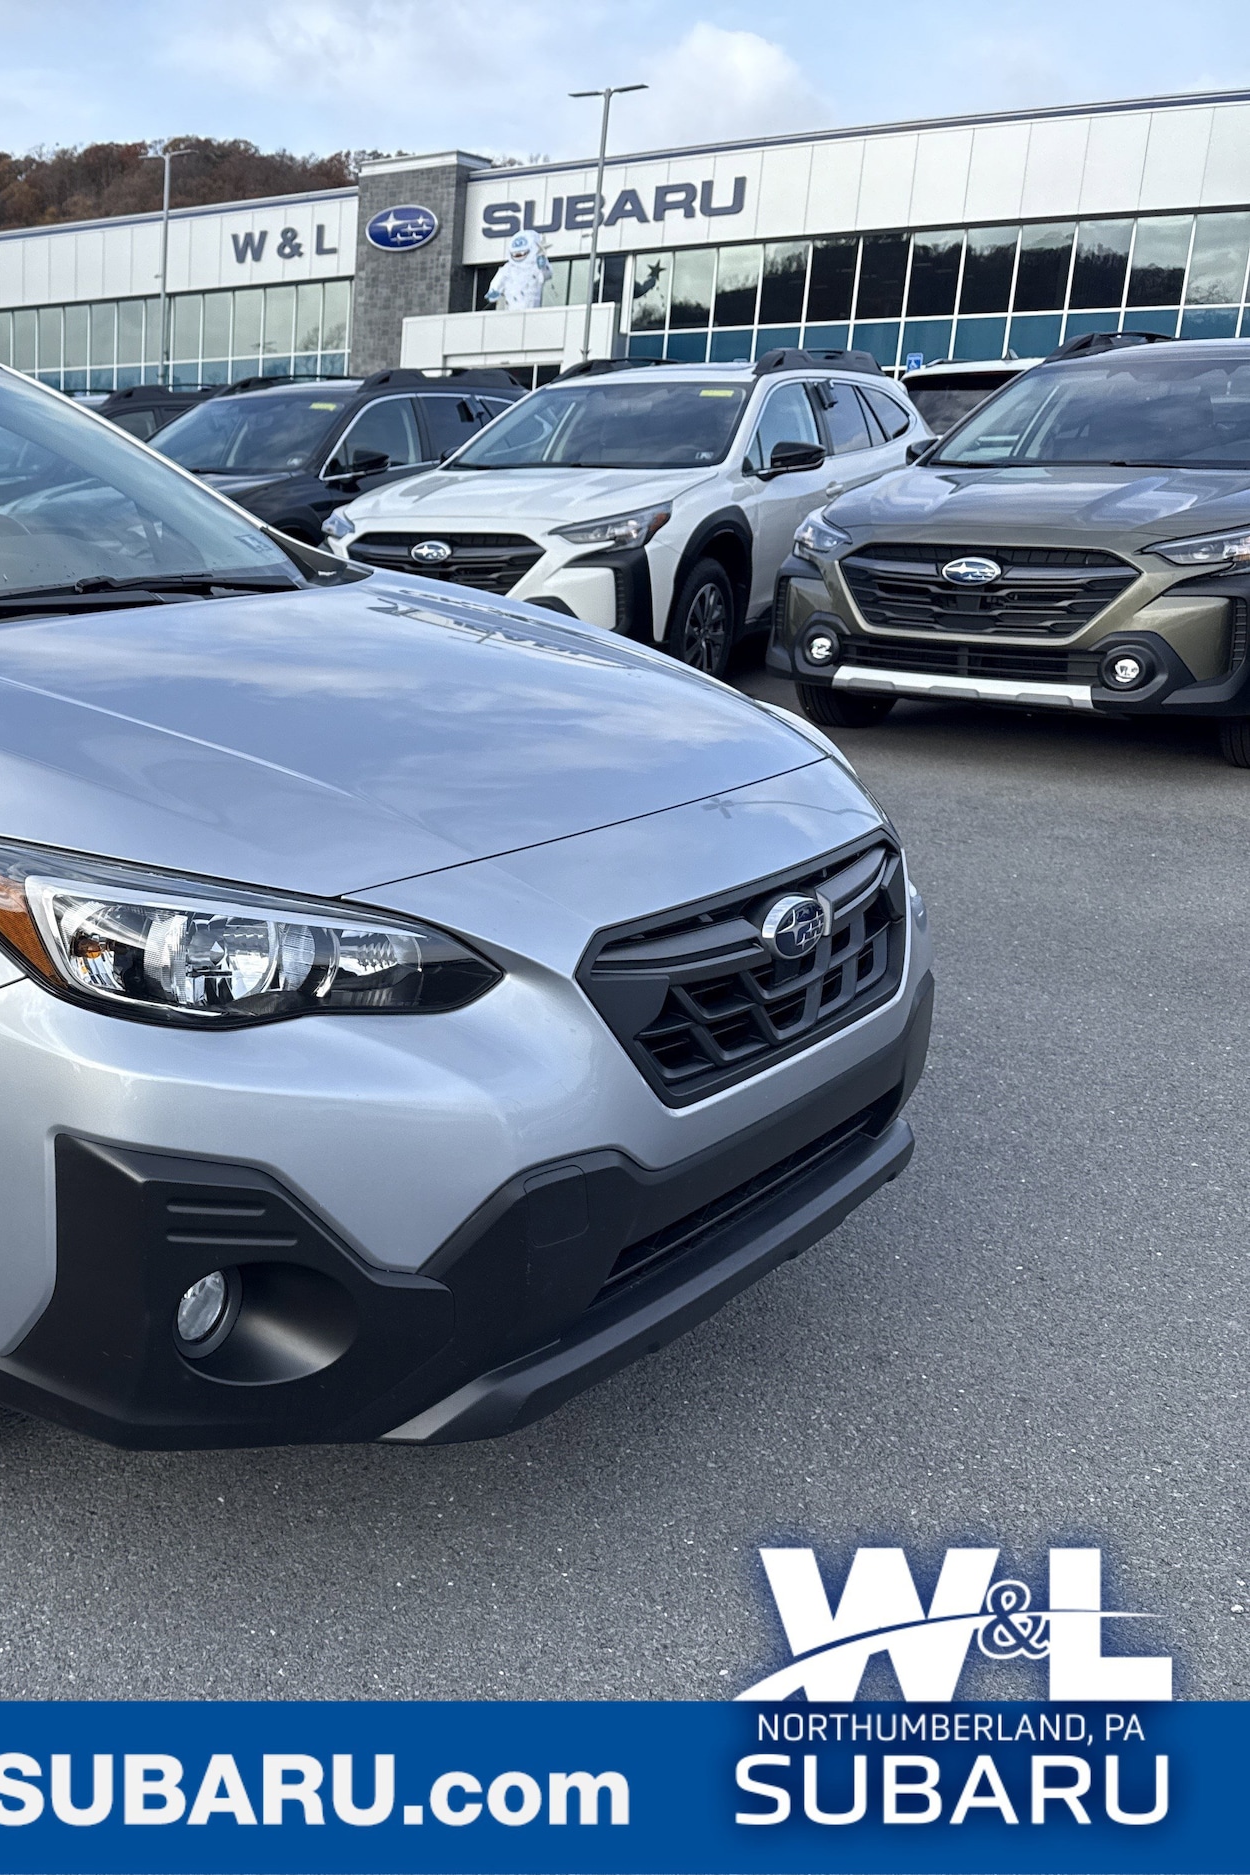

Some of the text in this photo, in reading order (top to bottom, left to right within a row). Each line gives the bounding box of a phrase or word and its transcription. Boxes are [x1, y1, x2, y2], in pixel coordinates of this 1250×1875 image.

[482, 176, 747, 239] SUBARU
[231, 224, 338, 264] W & L
